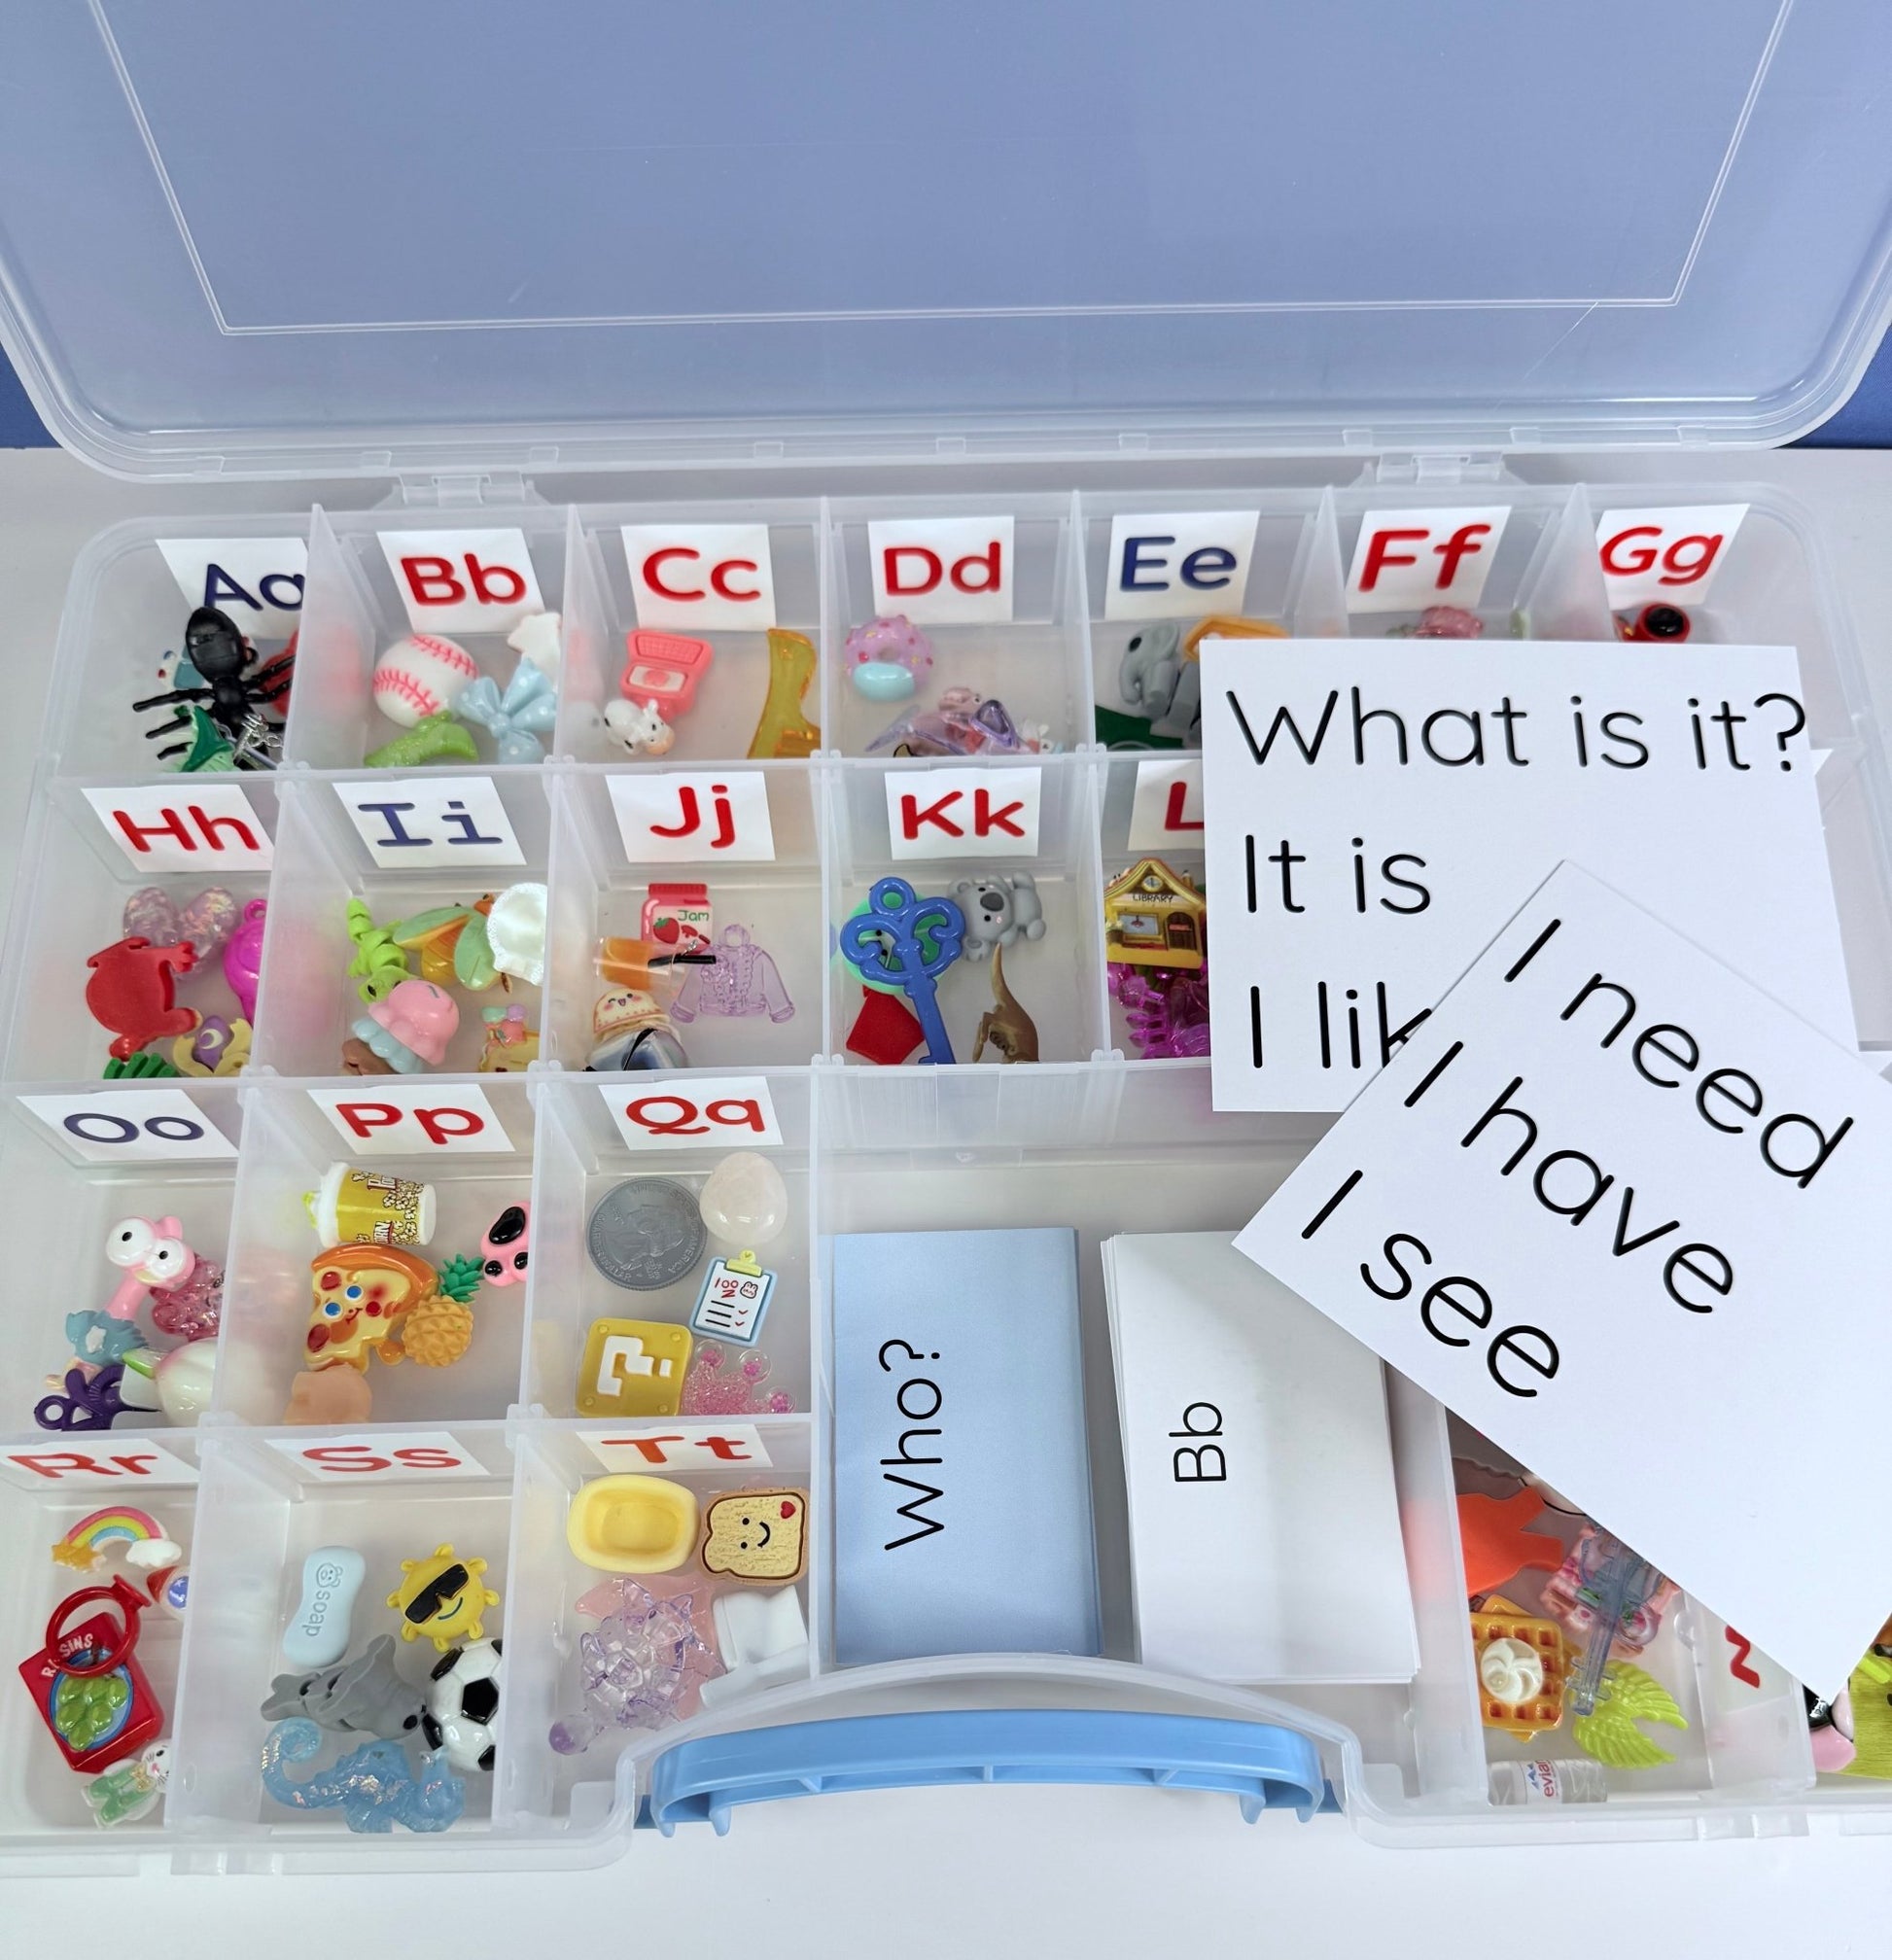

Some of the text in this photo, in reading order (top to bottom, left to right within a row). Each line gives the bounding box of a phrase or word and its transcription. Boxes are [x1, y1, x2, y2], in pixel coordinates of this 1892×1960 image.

[401, 553, 526, 606] Bb
[642, 547, 760, 602] Cc
[883, 541, 1001, 596] Dd
[1121, 536, 1237, 590] Ee
[1359, 524, 1491, 592] Ff
[1599, 526, 1724, 586] Gg
[203, 563, 305, 612] Aa
[1226, 685, 1806, 772] What is it?
[112, 805, 260, 853] Hh
[357, 800, 504, 847] Ii
[649, 784, 736, 849] Jj
[900, 788, 1025, 840] Kk
[1132, 893, 1174, 903] LIBRARY
[1245, 834, 1431, 915] It is
[678, 909, 710, 922] Jam
[1250, 985, 1263, 1068] I
[1503, 918, 1854, 1190] I need
[63, 1112, 205, 1143] Oo
[335, 1102, 484, 1145] Pp
[625, 1096, 765, 1135] Qq
[1403, 1039, 1734, 1313] I have
[1300, 1169, 1560, 1398] I see
[8, 1452, 158, 1479] Rr
[302, 1446, 463, 1472] Ss
[601, 1435, 753, 1464] Tt
[878, 1339, 945, 1552] Who?
[1168, 1401, 1227, 1483] Bb
[301, 1590, 332, 1637] soap
